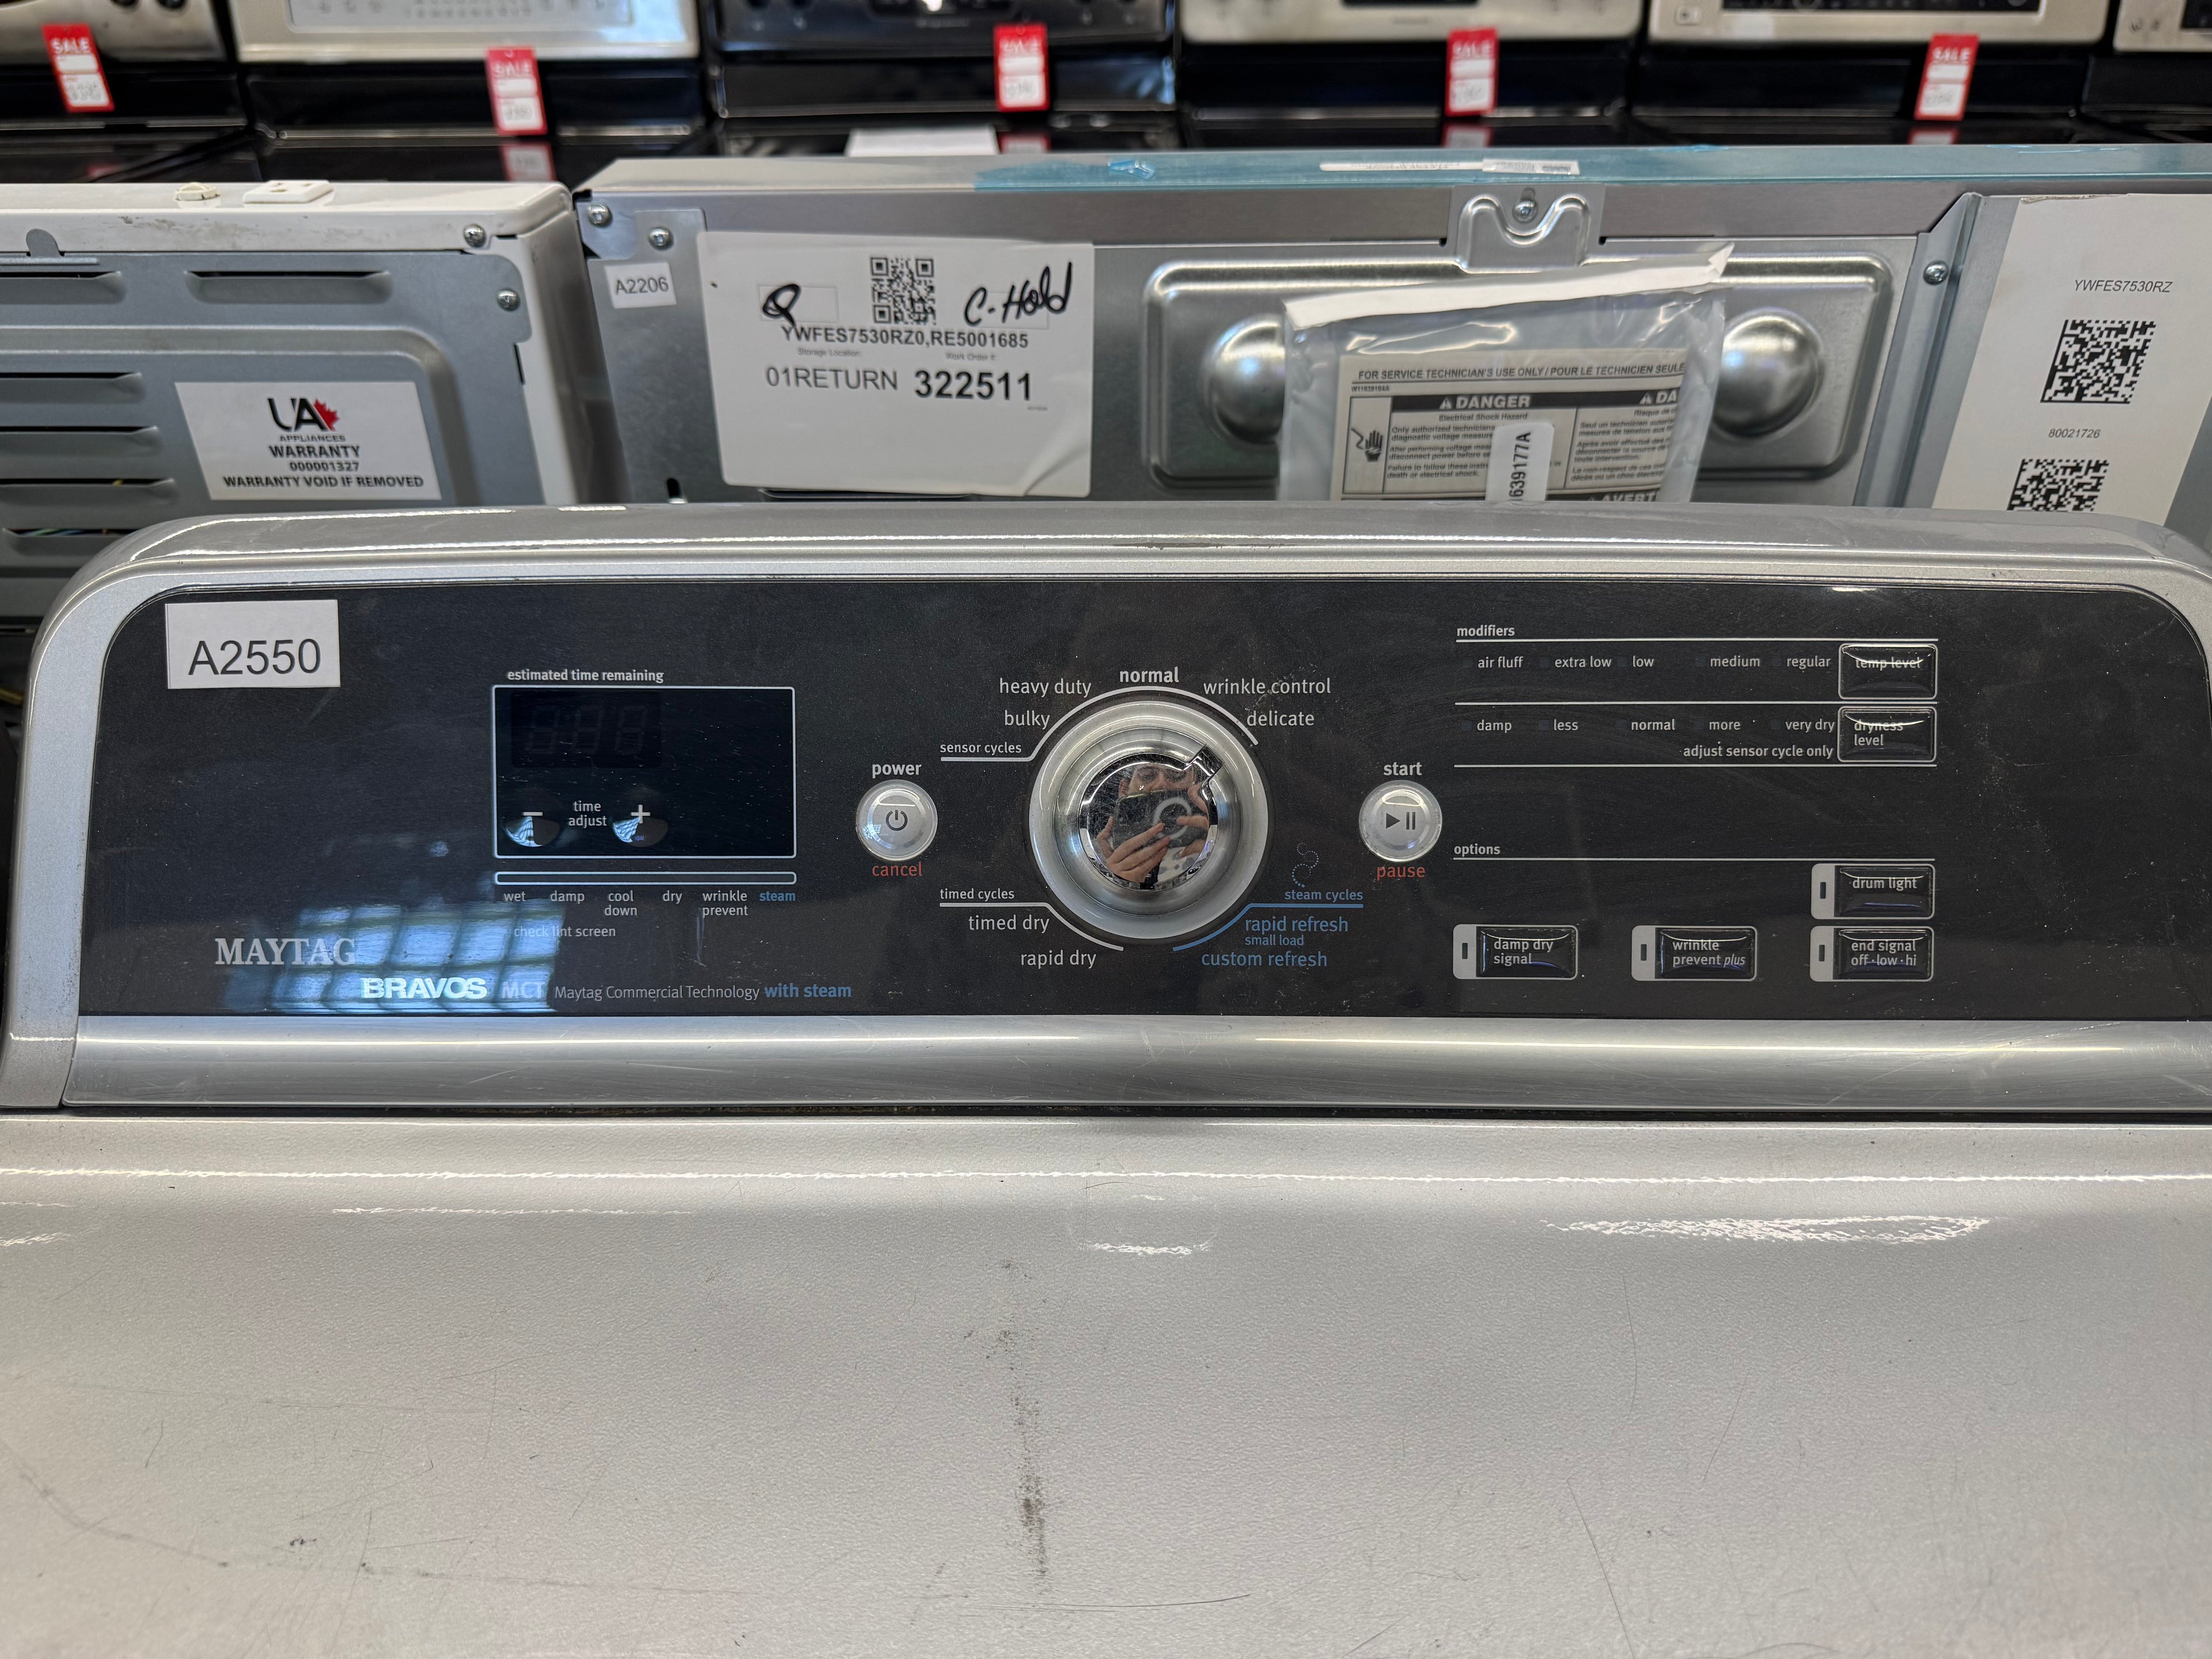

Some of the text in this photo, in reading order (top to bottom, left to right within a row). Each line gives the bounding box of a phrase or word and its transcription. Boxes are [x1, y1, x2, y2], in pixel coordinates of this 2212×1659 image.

[51, 38, 90, 54] SALE
[1452, 41, 1493, 59] SALE
[1931, 47, 1971, 63] SALE
[614, 276, 669, 296] A2206
[2074, 279, 2173, 293] YWFES7530RZ
[782, 325, 1029, 349] YWFES7530RZ0,RE5001685
[767, 367, 898, 390] 01RETURN
[1358, 370, 1378, 380] FOR
[1381, 369, 1423, 380] SERVICE
[1426, 368, 1494, 379] TECHNICIAN'S
[1495, 368, 1516, 377] USE
[1517, 367, 1544, 377] ONLY
[1550, 366, 1578, 376] POUR
[1580, 366, 1593, 376] LE
[1596, 364, 1653, 375] TECHNICIEN
[914, 370, 1031, 402] 322511
[1455, 394, 1531, 410] DANGER
[1655, 389, 1678, 404] DA
[1438, 414, 1474, 422] Electrical
[1501, 412, 1528, 421] Hazard
[1634, 409, 1660, 418] Risque
[1392, 426, 1409, 434] Only
[2048, 429, 2101, 439] 80021726
[269, 445, 361, 459] WARRANTY
[290, 461, 359, 471] 000001327
[223, 476, 424, 487] WARRANTY VOID IF REMOVED
[1601, 490, 1657, 502] AVERT
[1456, 624, 1516, 637] modifiers
[187, 638, 321, 676] A2550
[1478, 656, 1524, 668] air fluff
[1555, 656, 1612, 668] extra low
[1633, 656, 1654, 668] low
[1710, 656, 1760, 668] medium
[1786, 656, 1831, 670] regular
[1855, 657, 1921, 671] temp level
[507, 669, 664, 684] estimated time remaining
[1119, 666, 1179, 683] normal
[999, 677, 1092, 698] heavy duty
[1203, 677, 1331, 695] wrinkle control
[1005, 710, 1051, 730] bulky
[1247, 711, 1315, 727] delicate
[1476, 719, 1513, 733] damp
[1554, 719, 1578, 731] less
[1631, 718, 1676, 731] normal
[1709, 721, 1741, 730] more
[1785, 718, 1835, 733] very dry
[1854, 719, 1903, 733] dryness
[1854, 734, 1884, 746] level
[940, 742, 1022, 755] sensor cycles
[1683, 745, 1833, 759] adjust sensor cycle only
[872, 763, 922, 778] power
[1383, 761, 1422, 776] start
[573, 801, 601, 812] time
[569, 815, 607, 828] adjust
[1454, 843, 1501, 857] options
[872, 862, 923, 877] cancel
[1376, 866, 1426, 881] pause
[1852, 877, 1918, 891] drum light
[503, 892, 526, 902] wet
[550, 891, 585, 904] damp
[608, 890, 634, 902] cool
[662, 891, 683, 904] dry
[702, 890, 748, 902] wrinkle
[759, 891, 796, 902] steam
[940, 888, 1014, 902] timed cycles
[1285, 889, 1363, 903] steam cycles
[604, 905, 638, 916] down
[702, 906, 749, 918] prevent
[514, 925, 616, 937] check lint screen
[969, 915, 1050, 934] timed dry
[1245, 916, 1349, 935] rapid refresh
[1245, 934, 1304, 946] small load
[1493, 938, 1554, 952] damp dry
[1672, 939, 1719, 951] wrinkle
[1851, 940, 1916, 954] end signal
[214, 937, 357, 965] MAYTAG
[1020, 950, 1096, 969] rapid dry
[1201, 951, 1327, 967] custom refresh
[1493, 953, 1532, 967] signal
[1672, 953, 1745, 968] prevent plus
[361, 977, 488, 999] BRAVOS
[501, 980, 852, 1001] MCT Maytag Commercial Technology with steam
